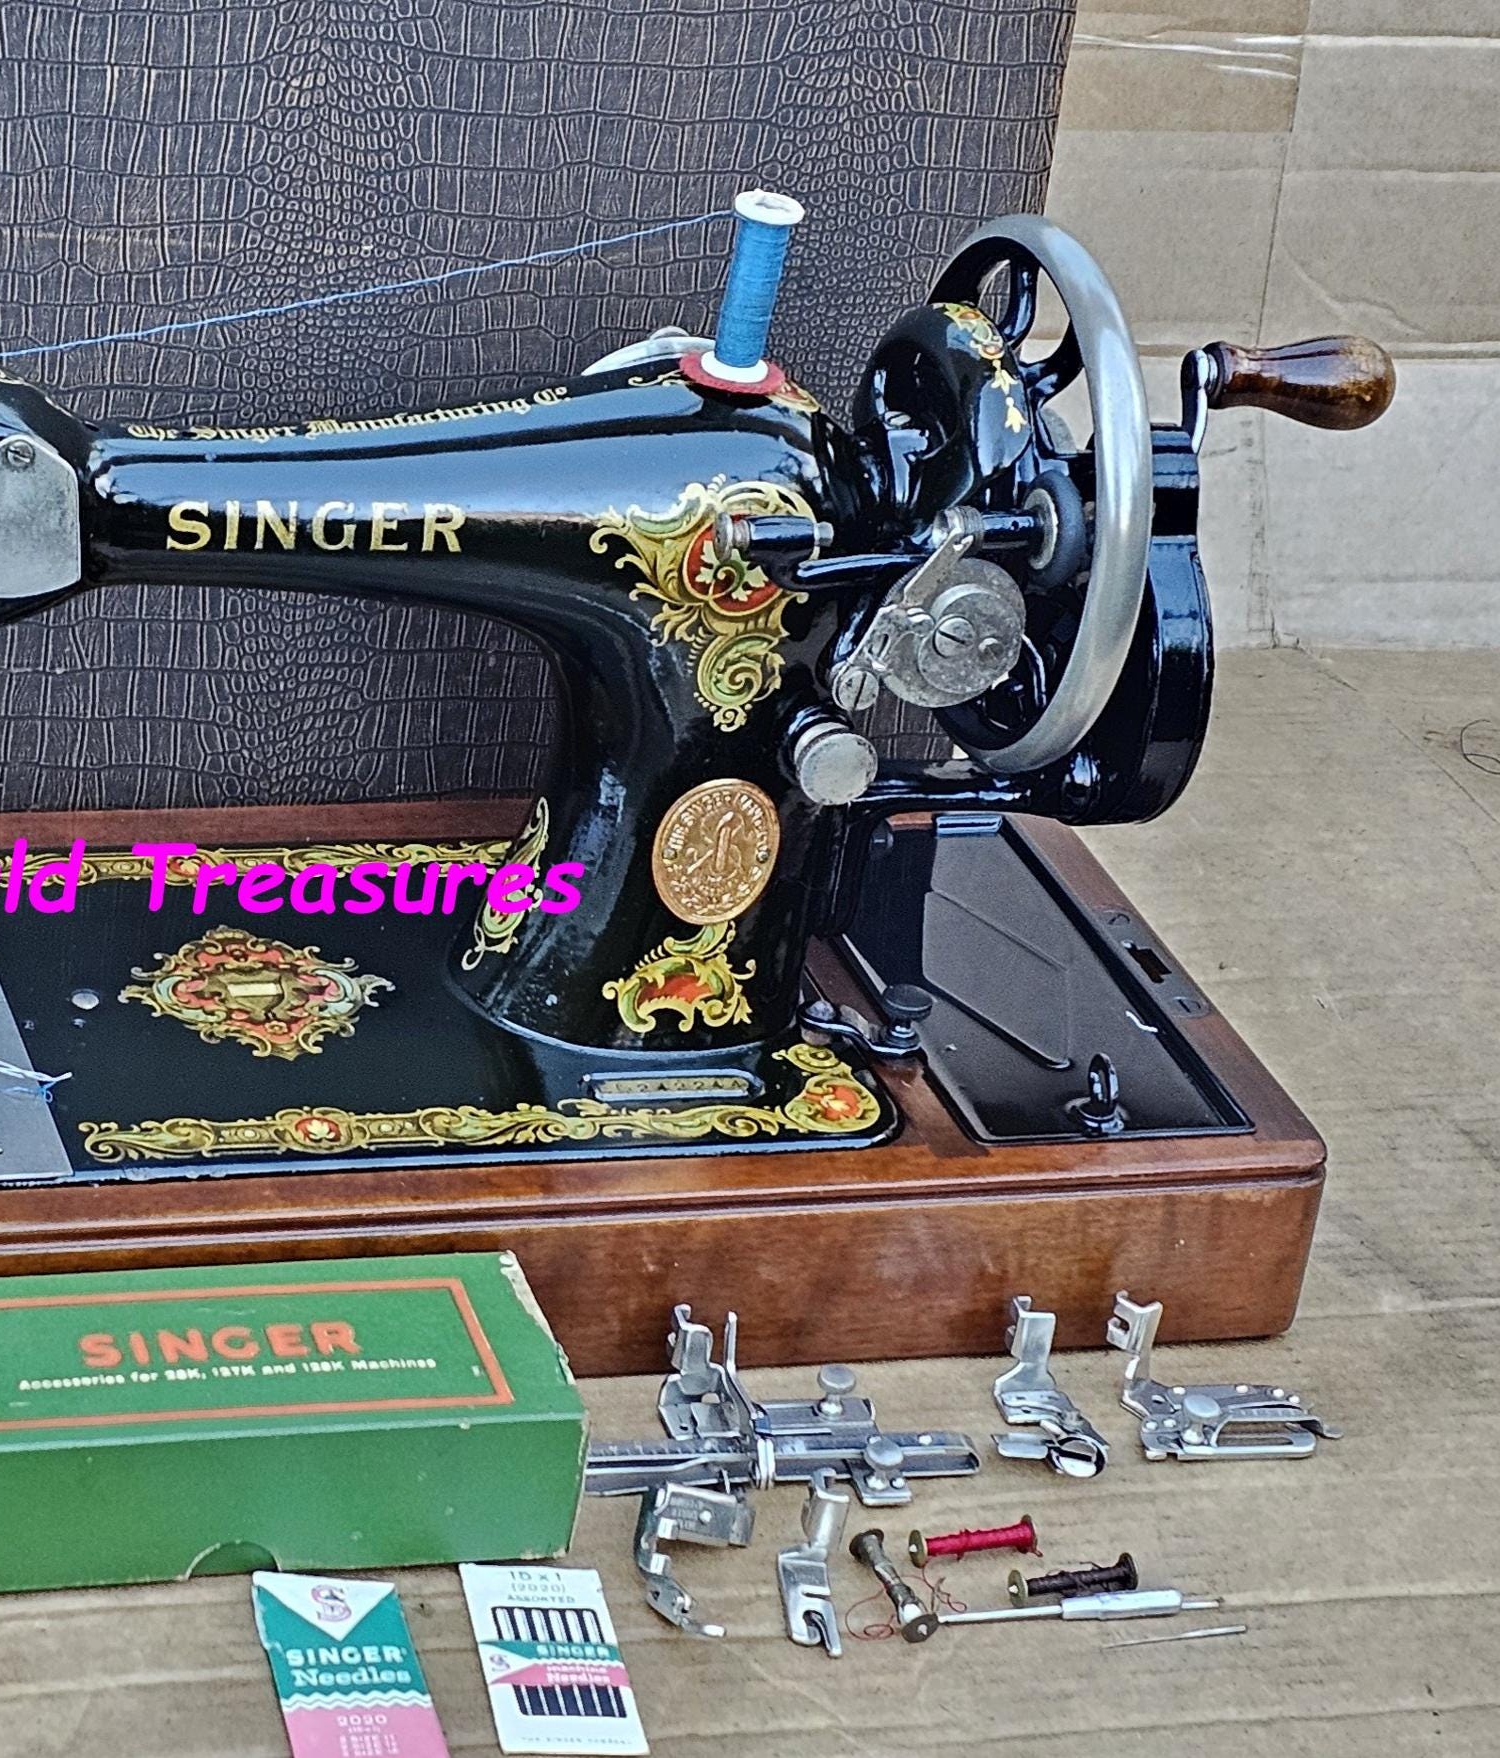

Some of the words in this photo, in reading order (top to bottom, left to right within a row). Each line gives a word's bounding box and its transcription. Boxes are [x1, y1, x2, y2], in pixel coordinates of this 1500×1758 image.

[127, 424, 179, 442] The
[187, 424, 299, 444] Singer
[303, 397, 532, 440] Manufacturing
[166, 499, 468, 554] SINGER
[79, 1321, 363, 1368] SINGER
[19, 1374, 126, 1391] Accessories
[130, 1370, 159, 1383] for
[261, 1362, 297, 1376] and
[351, 1357, 437, 1371] Machines
[285, 1645, 404, 1667] SINGER
[536, 1644, 610, 1658] SINGER
[290, 1665, 412, 1688] Needles
[336, 1713, 388, 1728] 2020
